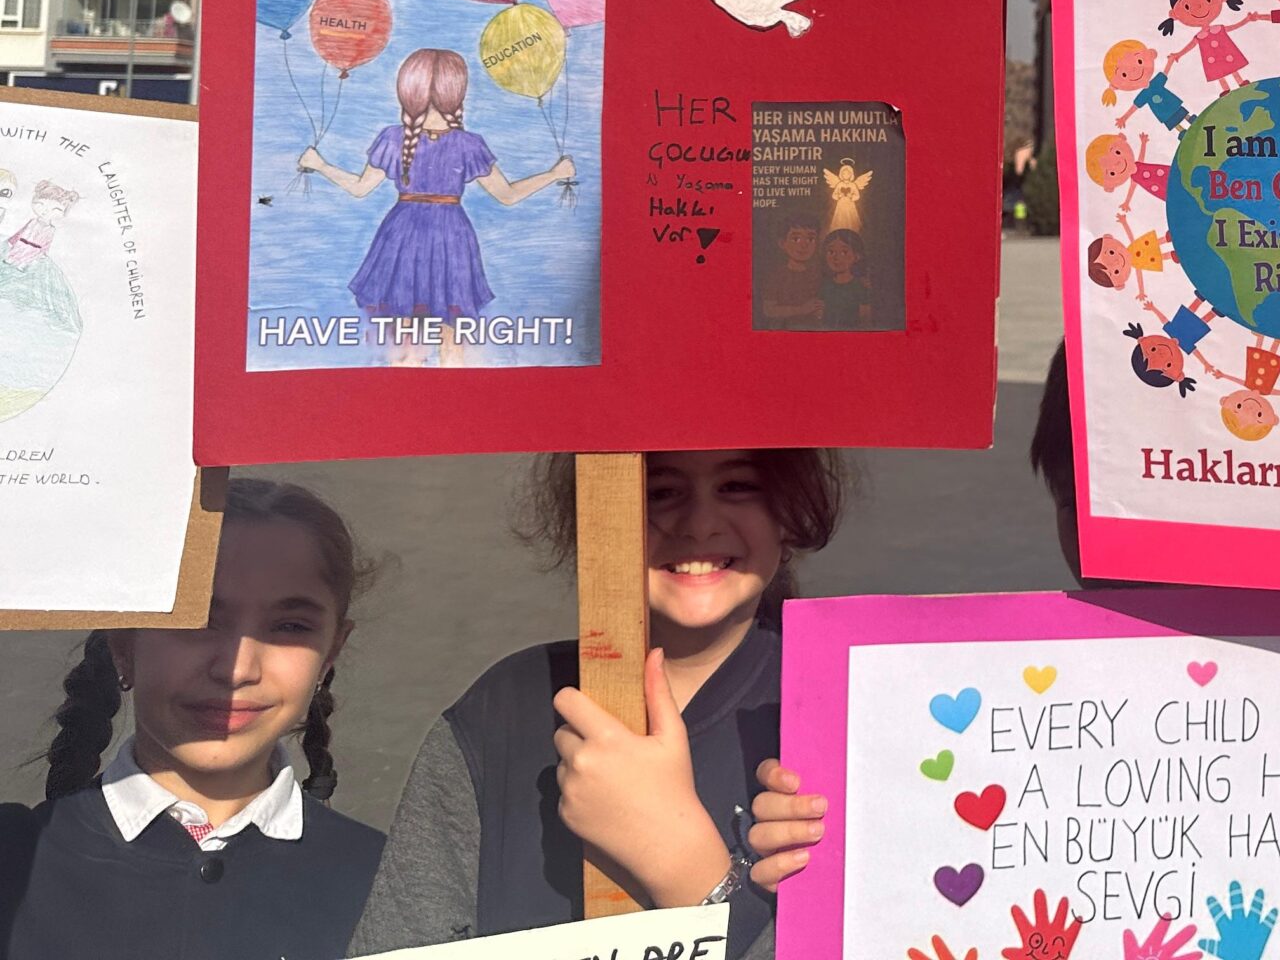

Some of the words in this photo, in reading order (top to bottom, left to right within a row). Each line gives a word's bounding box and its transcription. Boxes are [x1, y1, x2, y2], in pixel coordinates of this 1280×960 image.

[320, 16, 367, 31] HEALTH
[482, 32, 543, 70] EDUCATION
[655, 89, 737, 128] HER
[753, 111, 783, 125] HER
[753, 128, 816, 145] YAŞAMA
[820, 128, 888, 142] HAKKINA
[1203, 126, 1216, 158] I
[1225, 136, 1278, 158] am
[753, 166, 780, 174] EVERY
[783, 166, 817, 174] HUMAN
[753, 177, 771, 185] HAS
[773, 177, 790, 185] THE
[792, 176, 819, 185] RIGHT
[59, 136, 91, 157] THE
[97, 161, 133, 235] LAUGHTER
[123, 240, 137, 255] OF
[753, 188, 765, 197] TO
[767, 188, 785, 197] LIVE
[788, 187, 811, 197] WITH
[1209, 170, 1262, 201] Ben
[753, 199, 779, 208] HOPE.
[1215, 219, 1228, 247] I
[258, 316, 360, 346] HAVE
[371, 316, 444, 346] THE
[453, 316, 574, 346] RIGHT!
[990, 698, 1128, 753] EVERY
[1154, 697, 1259, 744] CHILD
[1017, 763, 1049, 809] A
[1077, 754, 1232, 808] LOVING
[991, 820, 1048, 870] EN
[1066, 813, 1203, 865] BÜYÜK
[1071, 862, 1197, 924] SEVGİ
